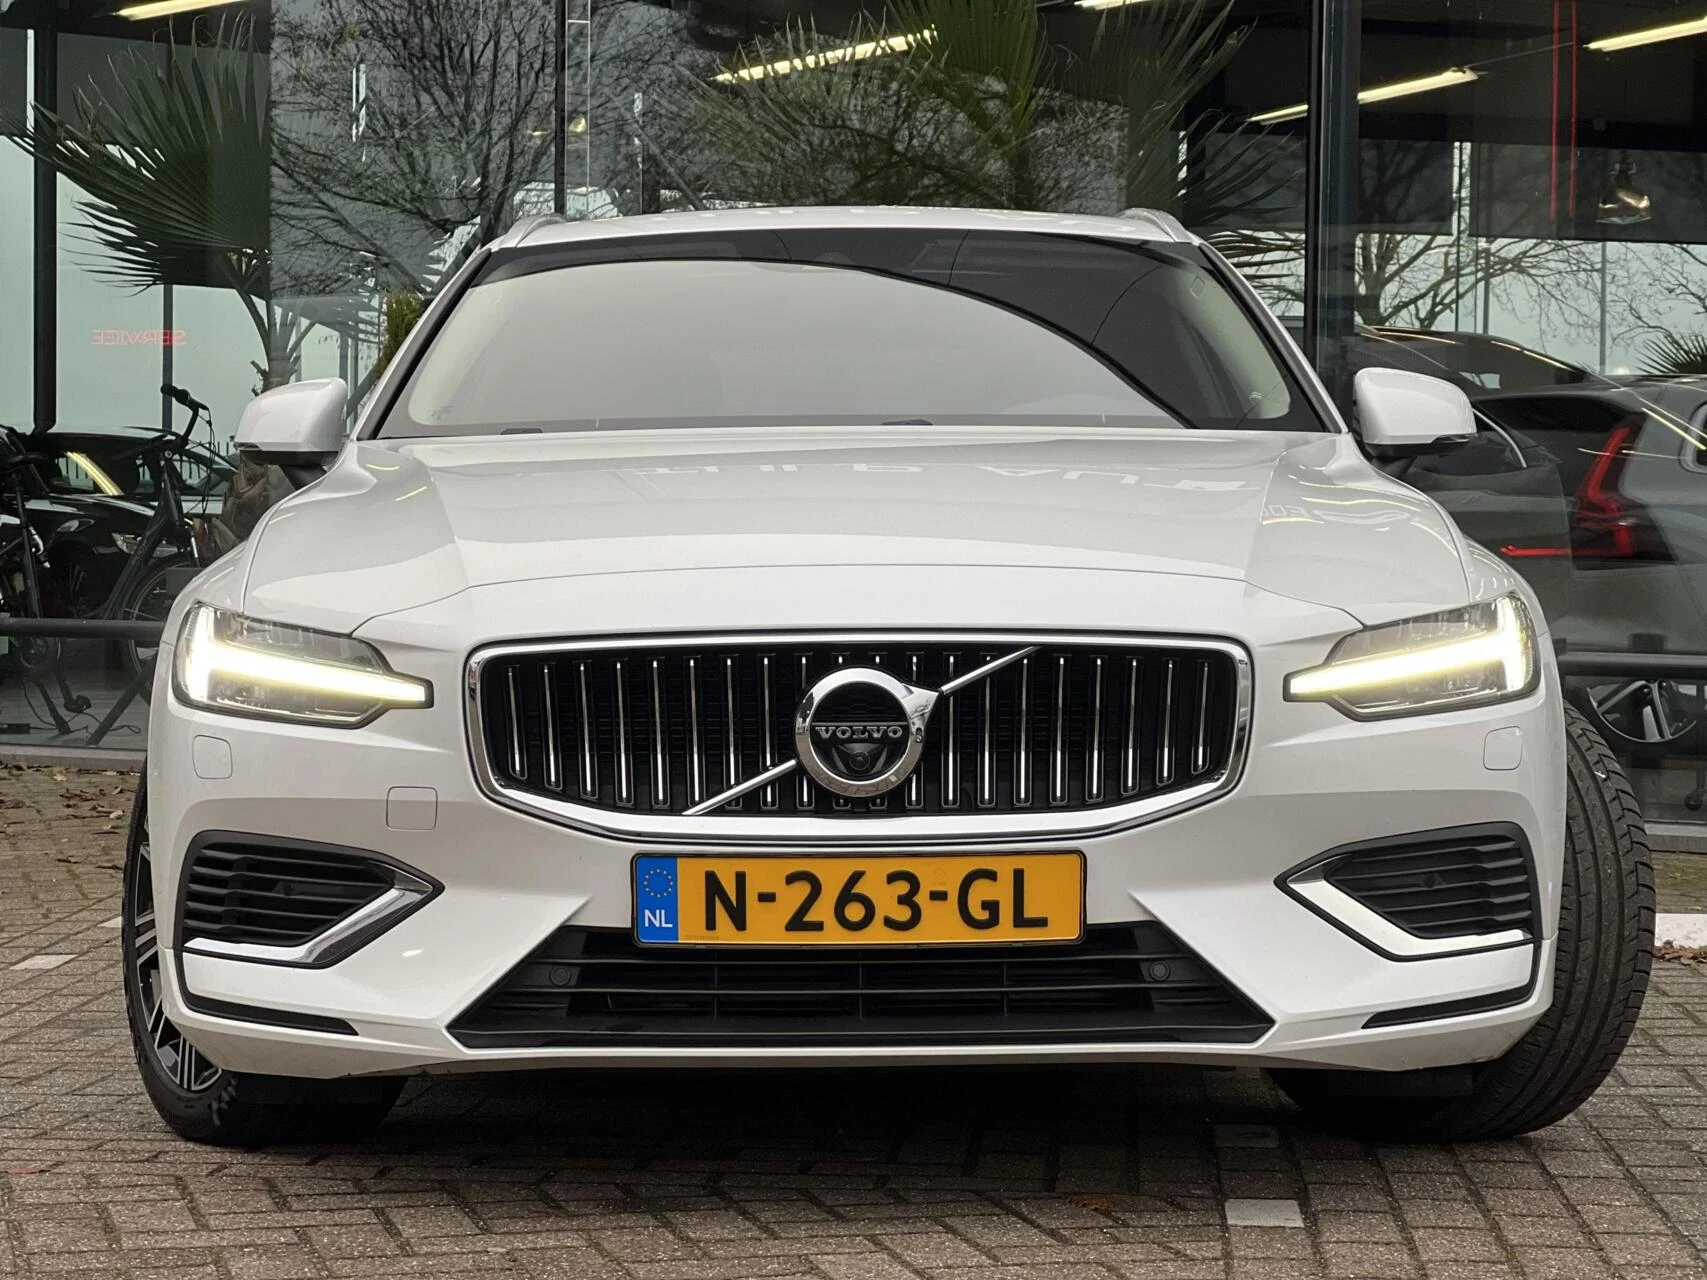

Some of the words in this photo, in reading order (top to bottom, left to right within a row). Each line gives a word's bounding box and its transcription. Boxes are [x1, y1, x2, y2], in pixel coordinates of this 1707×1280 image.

[815, 726, 903, 739] VOLVO
[704, 868, 1049, 931] N-263-GL
[643, 910, 673, 928] NL
